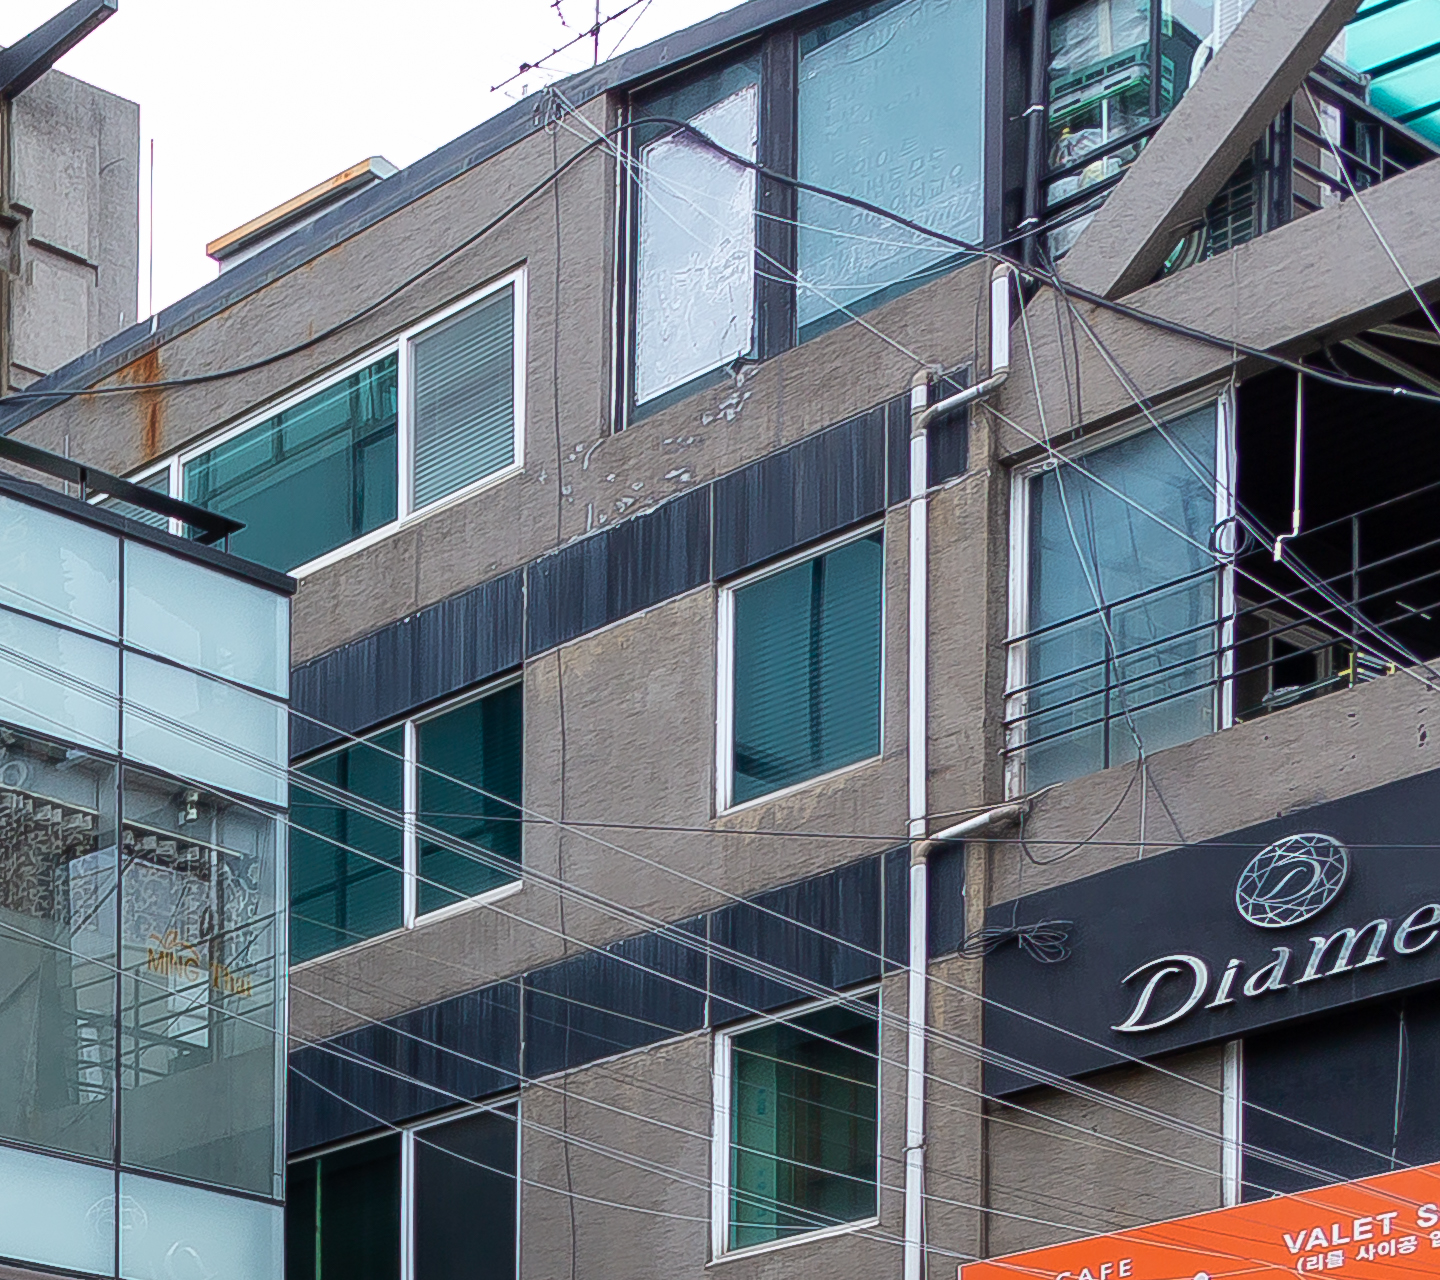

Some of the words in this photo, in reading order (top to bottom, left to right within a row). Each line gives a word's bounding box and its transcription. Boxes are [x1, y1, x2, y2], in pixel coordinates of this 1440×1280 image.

[147, 947, 200, 983] MING
[209, 961, 252, 998] Thai
[1283, 1211, 1398, 1254] VALET
[1355, 1235, 1418, 1261] 사이공
